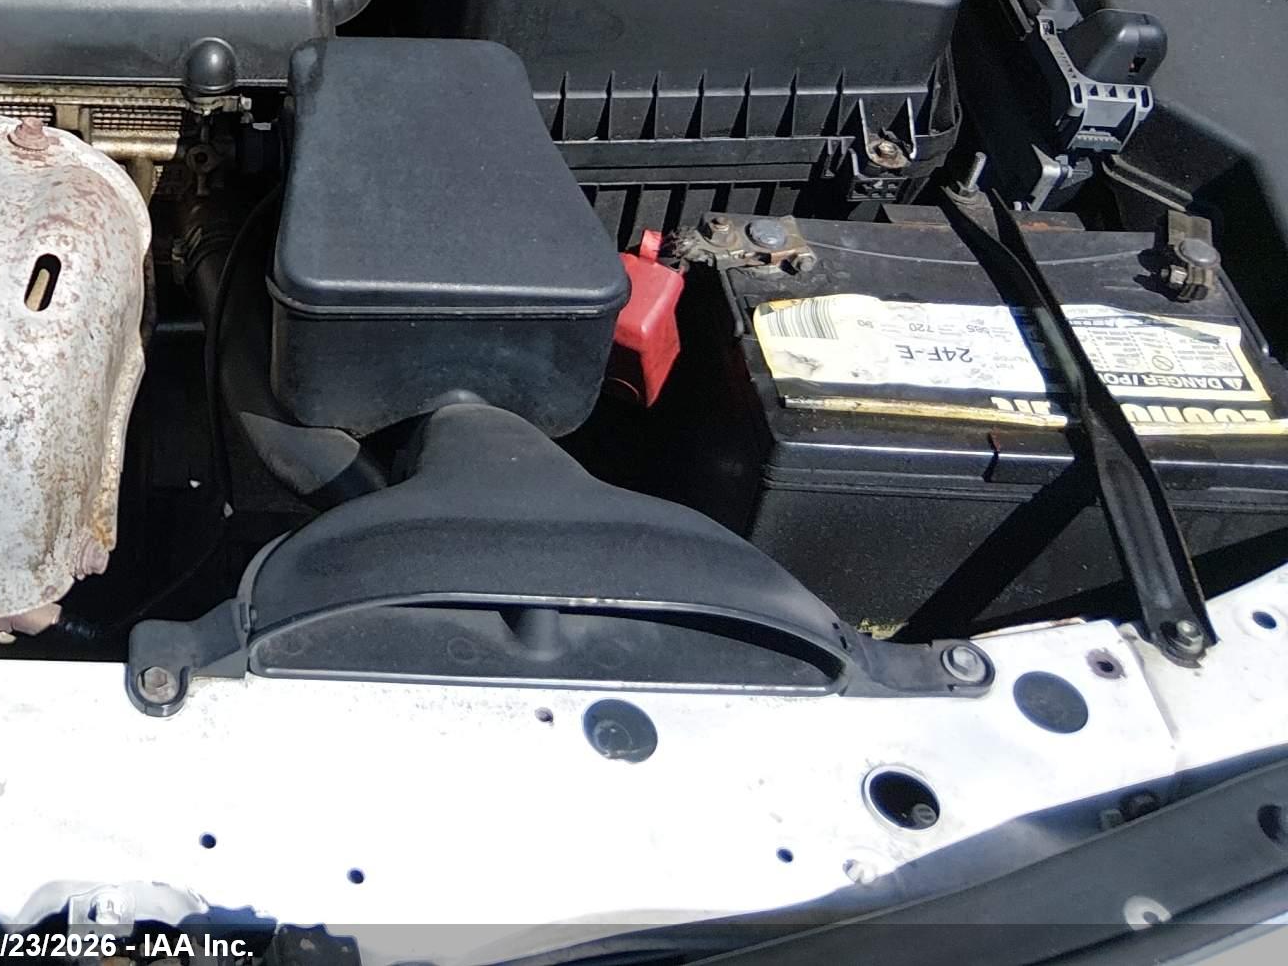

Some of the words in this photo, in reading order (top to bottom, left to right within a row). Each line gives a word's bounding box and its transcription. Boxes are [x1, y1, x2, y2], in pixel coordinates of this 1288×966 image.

[908, 322, 935, 334] 720
[895, 344, 974, 364] 24F-E
[1142, 374, 1224, 391] DANGER
